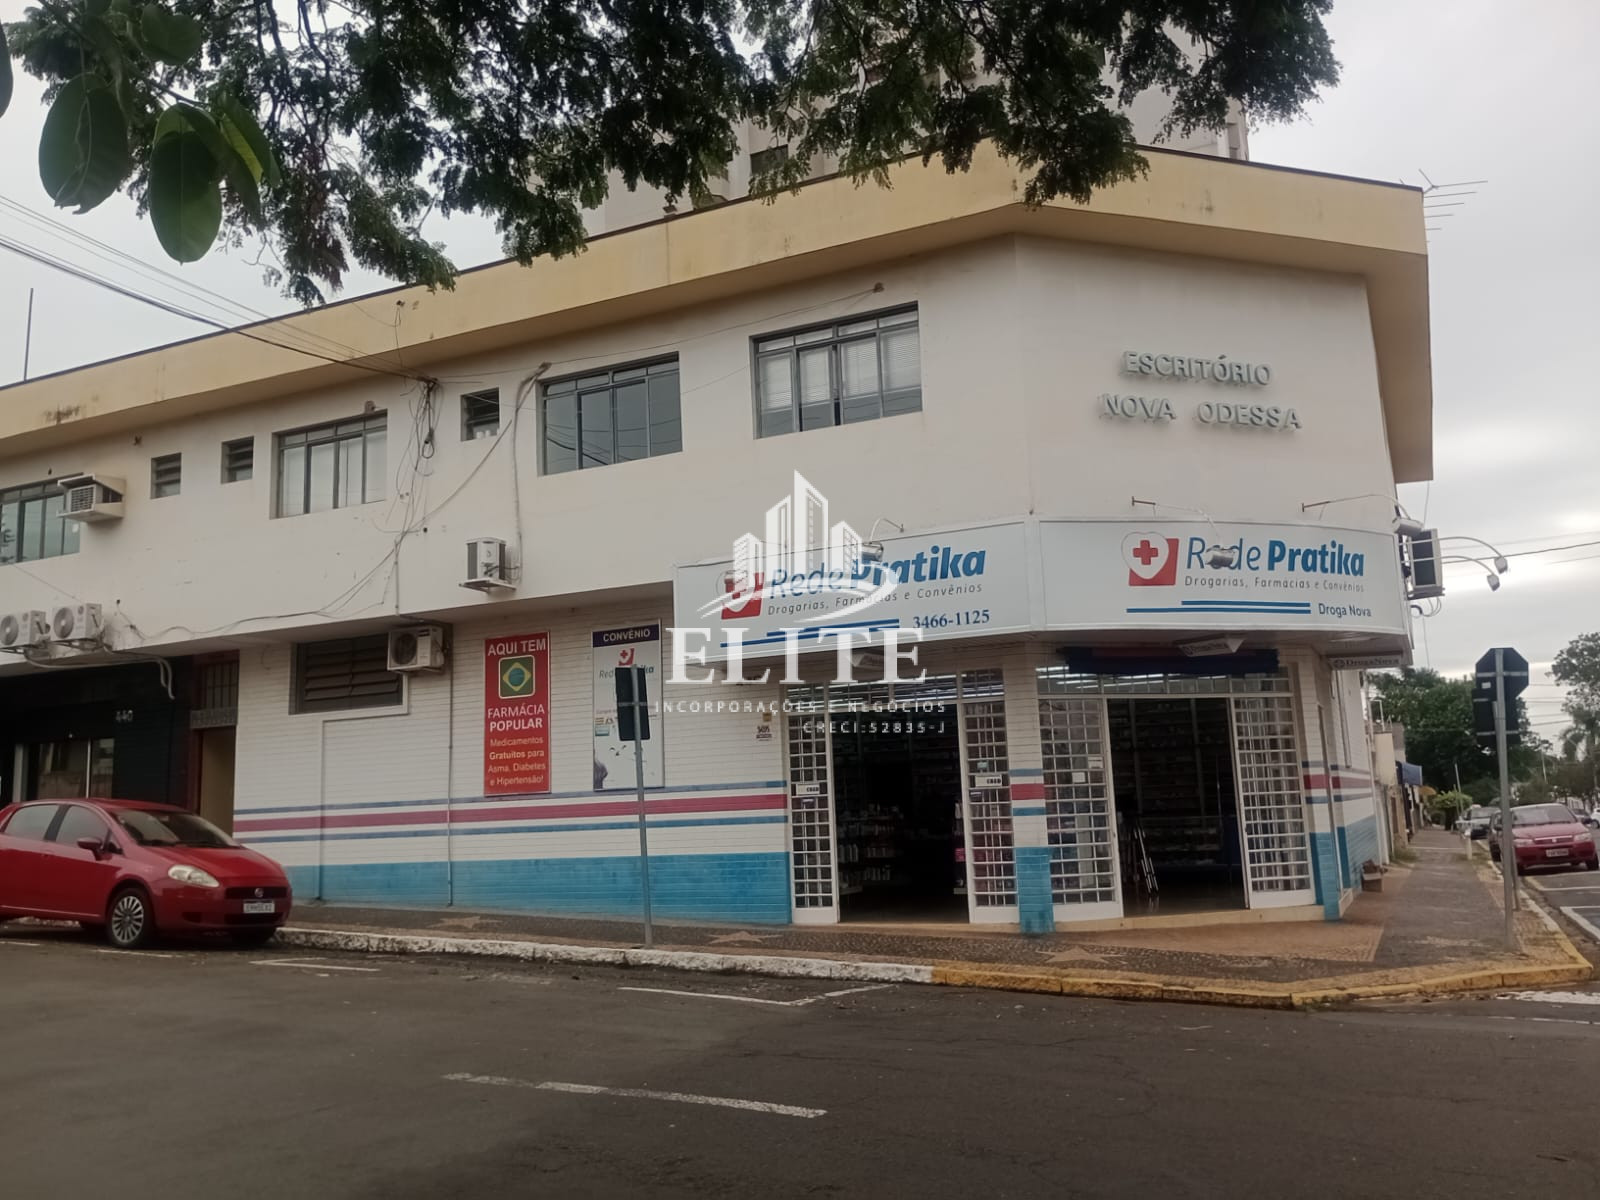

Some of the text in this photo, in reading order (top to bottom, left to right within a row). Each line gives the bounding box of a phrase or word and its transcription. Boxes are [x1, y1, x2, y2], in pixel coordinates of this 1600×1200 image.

[1122, 351, 1272, 385] ESCRITÓRIO
[1100, 394, 1302, 429] NOVA ODESSA
[1187, 536, 1365, 577] Rde Pratika
[1184, 575, 1248, 589] Drogarias,
[1254, 576, 1310, 589] Farmácias
[768, 602, 829, 616] Drogarias,
[904, 591, 910, 599] e
[917, 583, 982, 599] Convênios
[1318, 603, 1372, 618] Droga Nova
[913, 609, 990, 629] 3466-1125
[603, 628, 651, 643] CONVÊNIO
[487, 638, 547, 657] AQUI TEM
[487, 703, 545, 719] FARMÁCIA
[489, 717, 543, 733] POPULAR
[490, 736, 544, 747] Medicamentos
[489, 750, 545, 760] Gratuitos para
[512, 762, 546, 772] Diabetes
